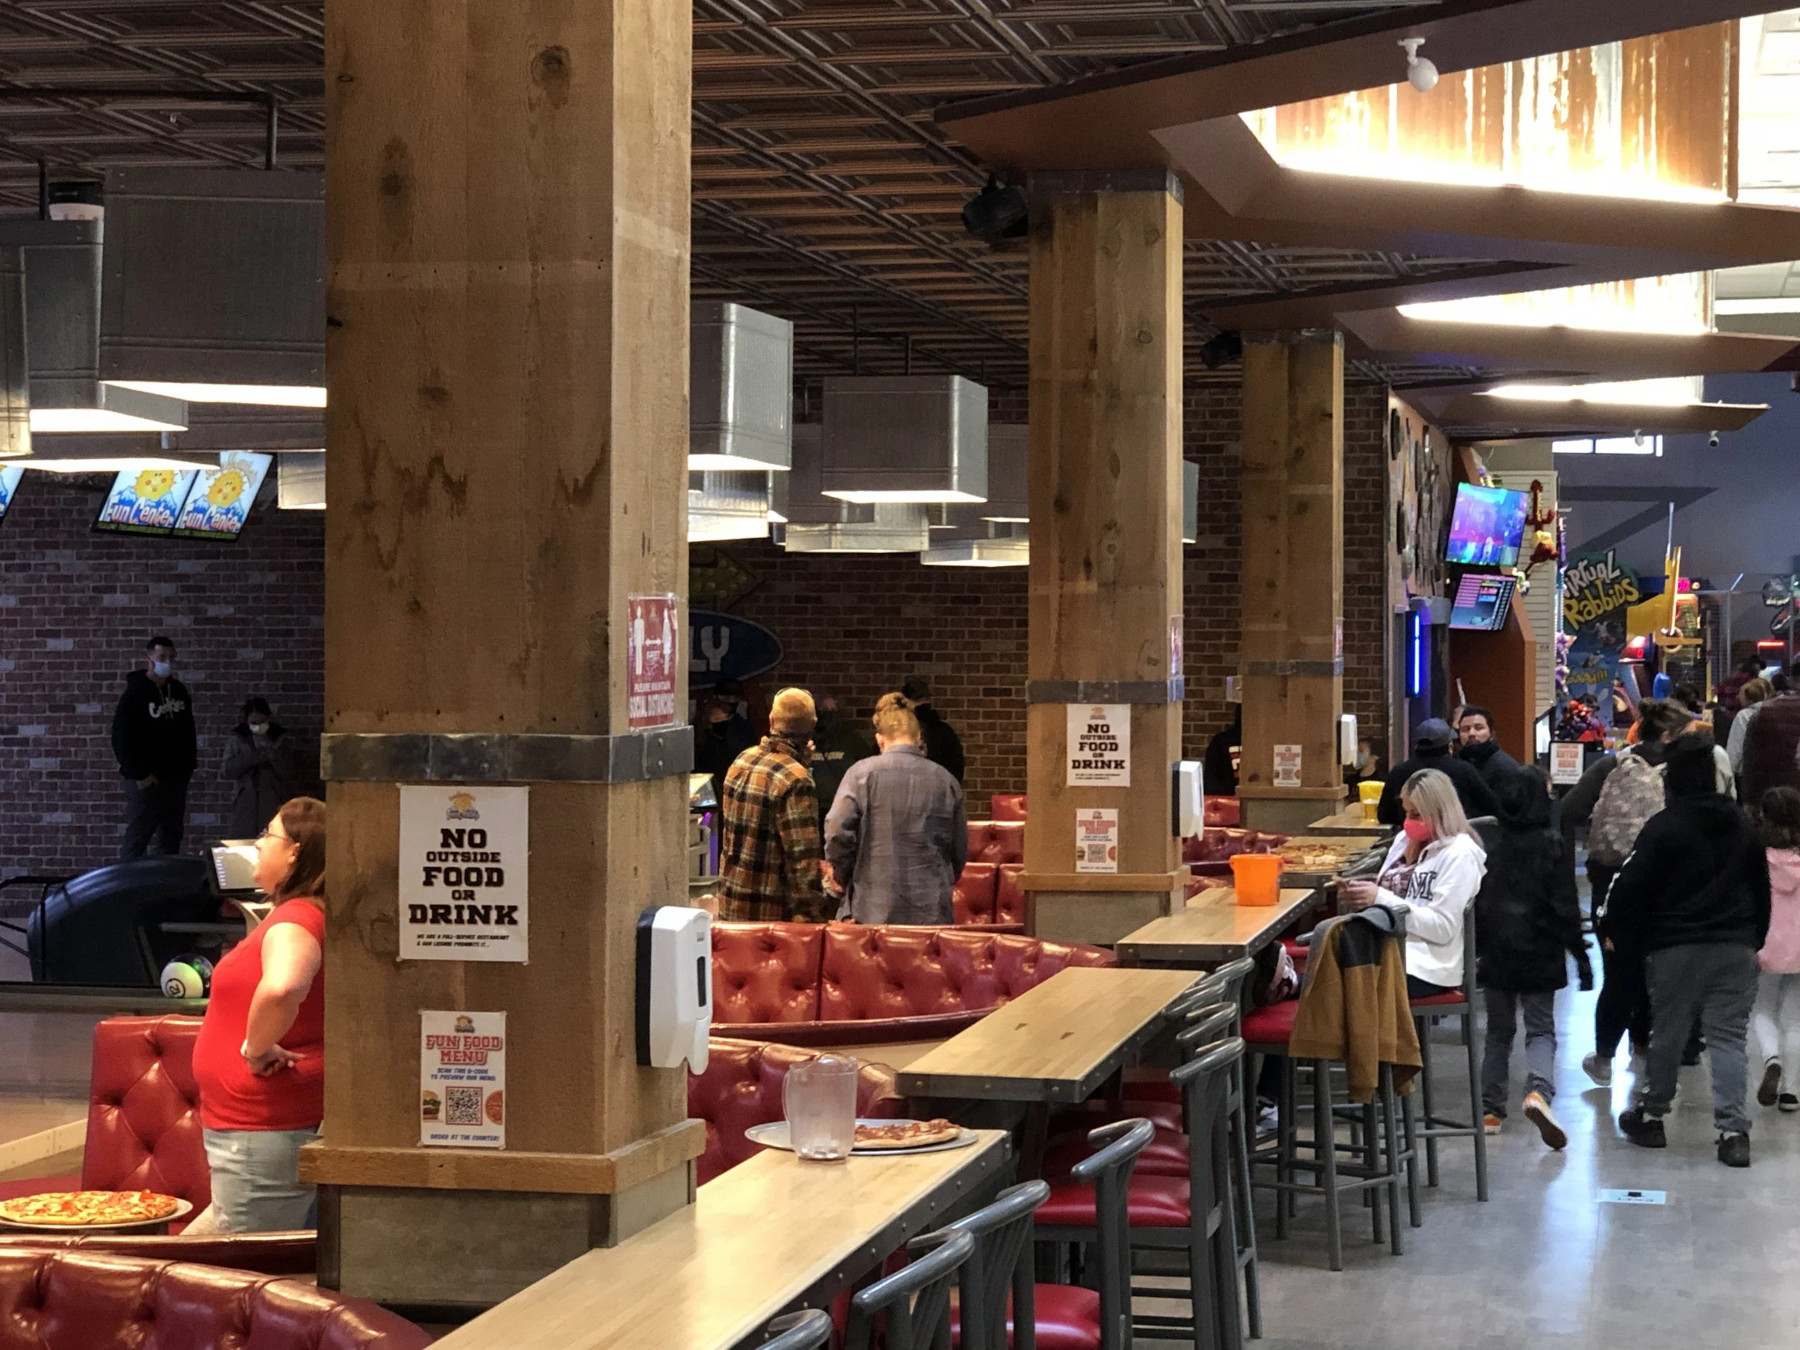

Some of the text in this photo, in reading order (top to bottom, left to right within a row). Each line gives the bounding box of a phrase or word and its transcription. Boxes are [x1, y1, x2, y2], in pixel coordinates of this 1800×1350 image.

[105, 495, 174, 528] Fun Center
[180, 502, 241, 532] Fun Center
[1087, 723, 1110, 734] NO
[1079, 742, 1119, 751] FOOD
[1071, 759, 1125, 770] DRINK
[440, 828, 487, 849] NO
[426, 851, 501, 863] OUTSIDE
[422, 866, 504, 887] FOOD
[451, 889, 476, 901] OR
[408, 903, 519, 925] DRINK
[426, 1034, 503, 1050] FUN FOOD
[440, 1050, 488, 1065] MENU
